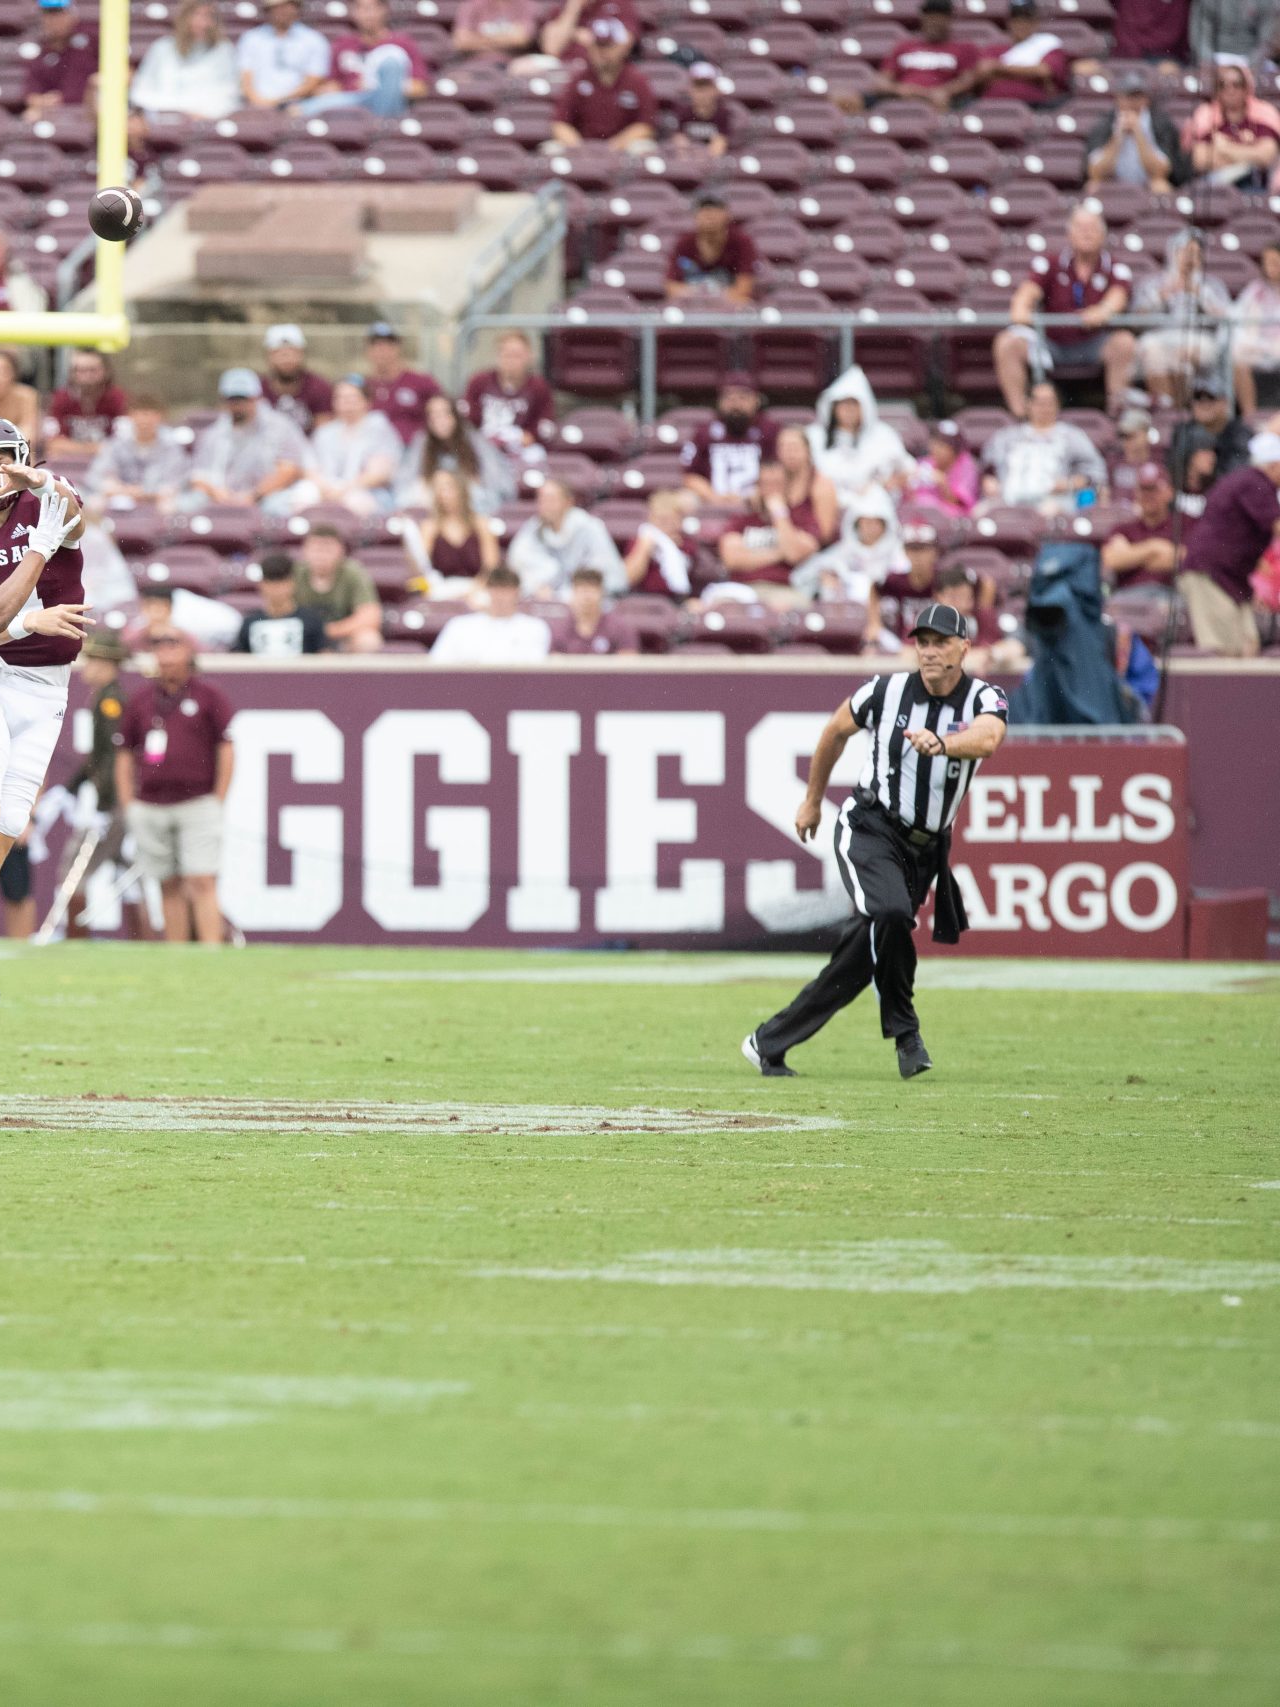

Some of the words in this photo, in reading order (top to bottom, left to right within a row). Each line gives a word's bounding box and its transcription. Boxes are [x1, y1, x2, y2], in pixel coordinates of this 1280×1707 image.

[947, 761, 960, 778] C
[963, 773, 1175, 843] ELLS
[920, 862, 1178, 932] ARGO
